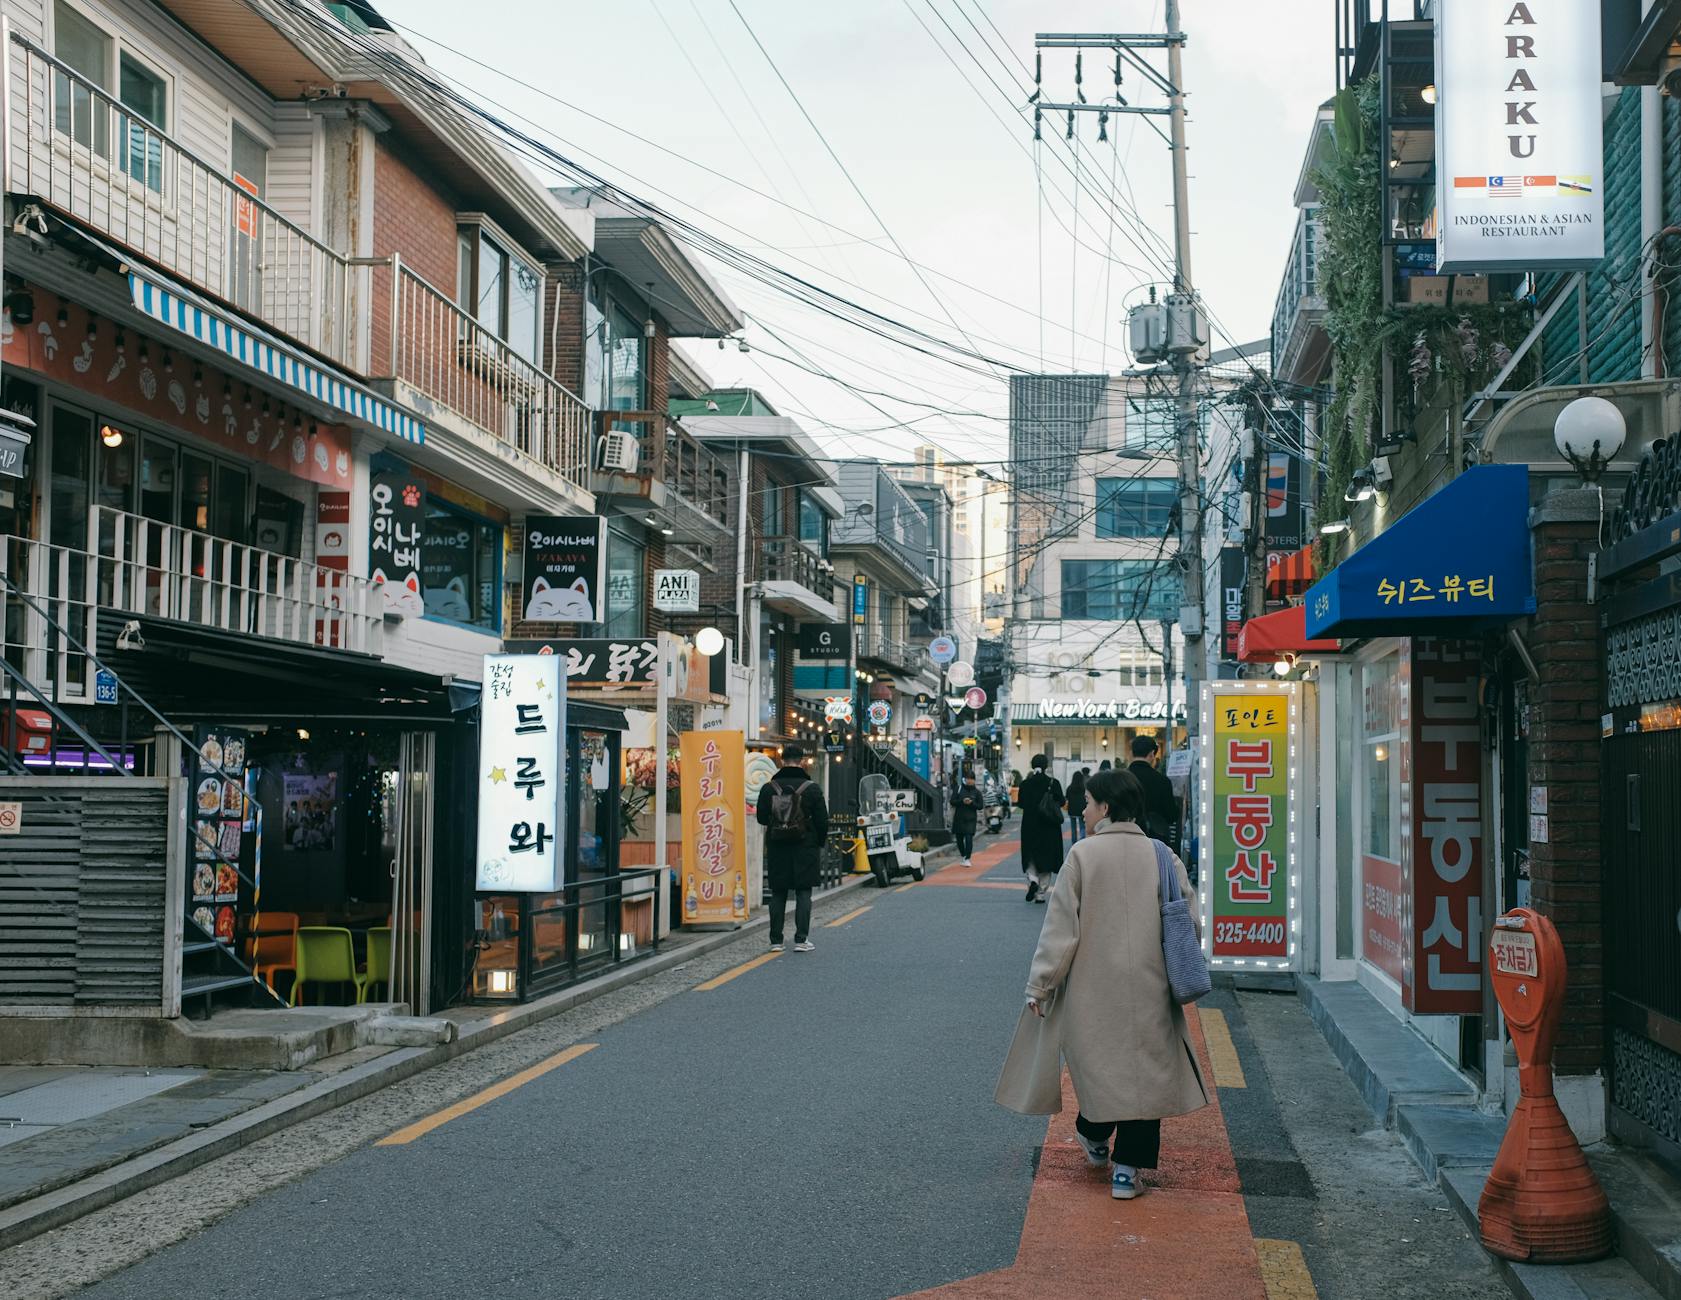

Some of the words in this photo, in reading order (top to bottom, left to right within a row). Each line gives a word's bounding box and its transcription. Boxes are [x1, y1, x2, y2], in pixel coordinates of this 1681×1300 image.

[1504, 2, 1539, 159] ARAKU
[1454, 213, 1537, 226] INDONESIAN
[1541, 214, 1549, 224] &
[1552, 213, 1593, 224] ASIAN
[1481, 226, 1566, 238] RESTAURANT
[529, 531, 595, 549] 오이시나베
[660, 576, 688, 589] ANI
[658, 590, 689, 600] PLAZA
[819, 631, 832, 645] G
[490, 664, 514, 678] 감성
[491, 679, 514, 700] 술집
[1225, 708, 1280, 729] 포인트
[508, 703, 554, 857] 드루와
[1226, 738, 1277, 904] 부동산
[1215, 922, 1285, 946] 325-4400
